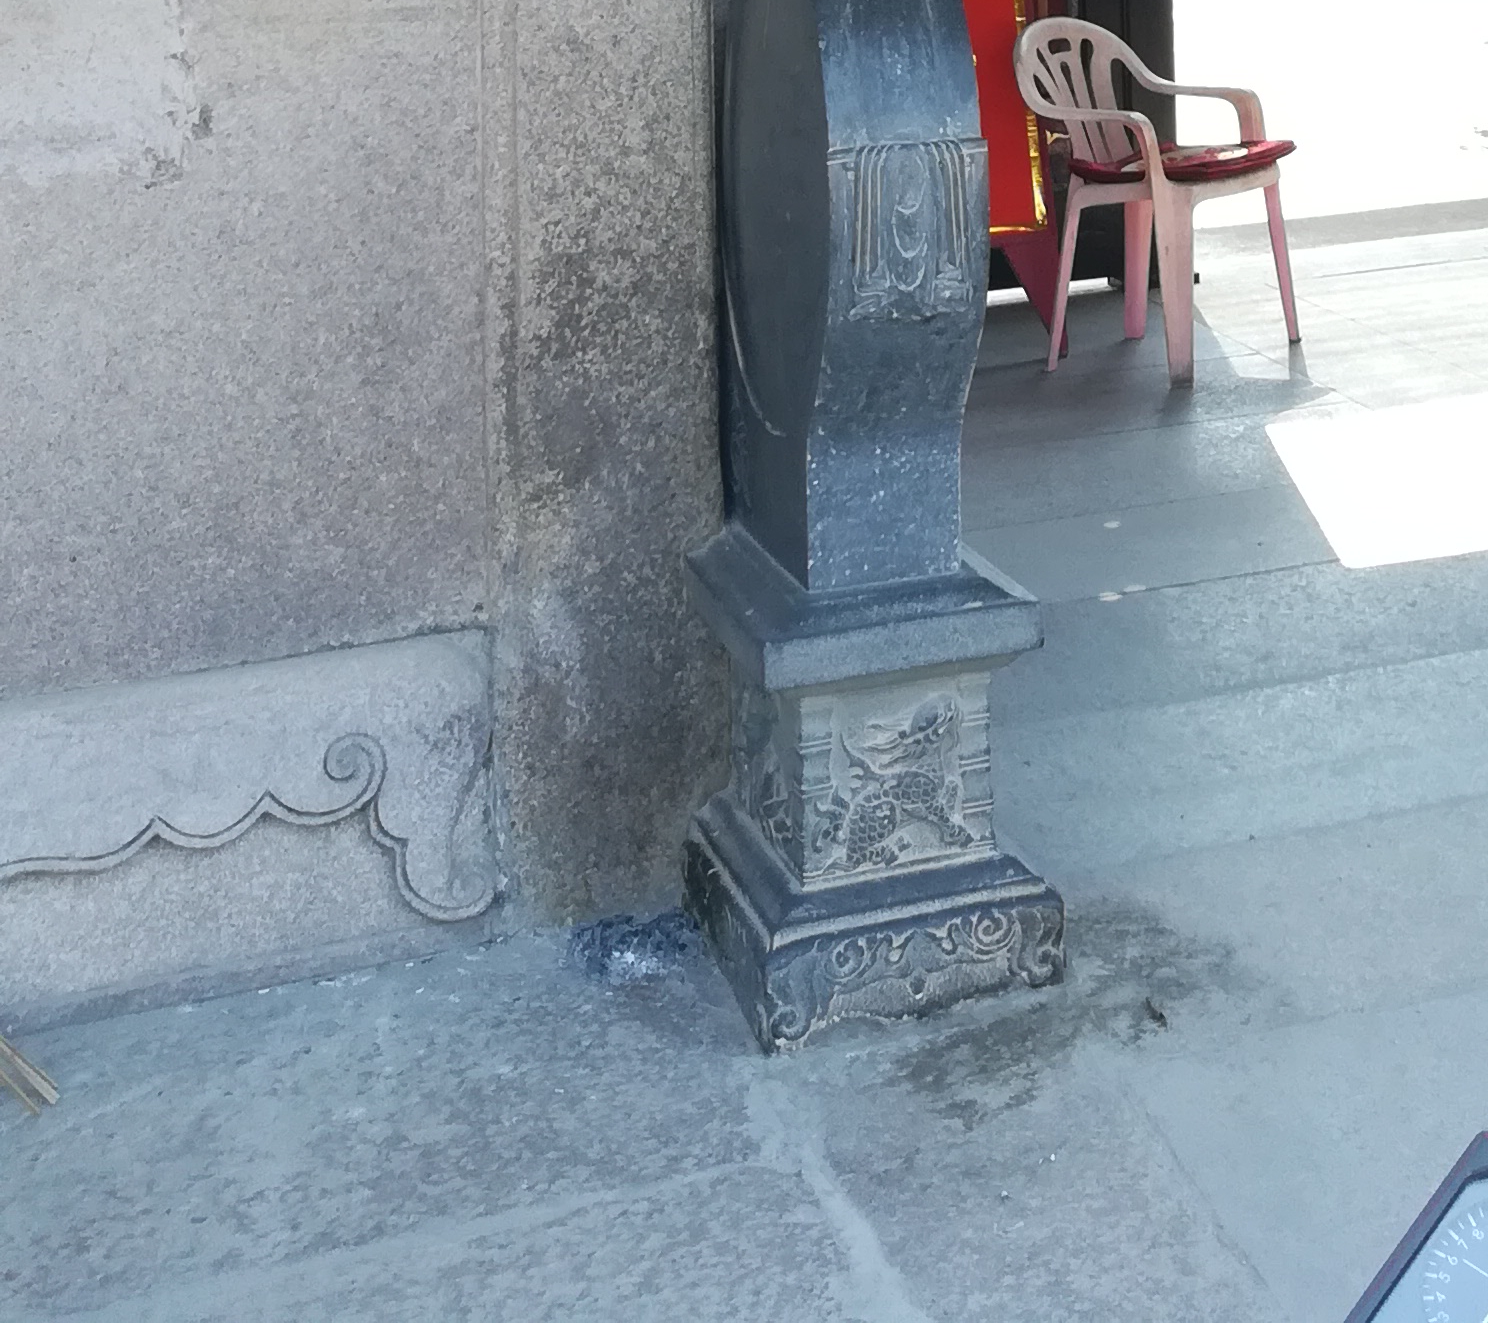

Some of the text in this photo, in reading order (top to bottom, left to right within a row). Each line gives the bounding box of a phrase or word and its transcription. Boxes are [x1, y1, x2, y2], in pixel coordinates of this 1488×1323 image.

[1472, 1228, 1485, 1241] 8
[1457, 1239, 1469, 1250] 7
[1446, 1254, 1459, 1266] 6
[1437, 1271, 1451, 1284] 5
[1435, 1291, 1447, 1303] 4
[1437, 1311, 1450, 1323] 3
